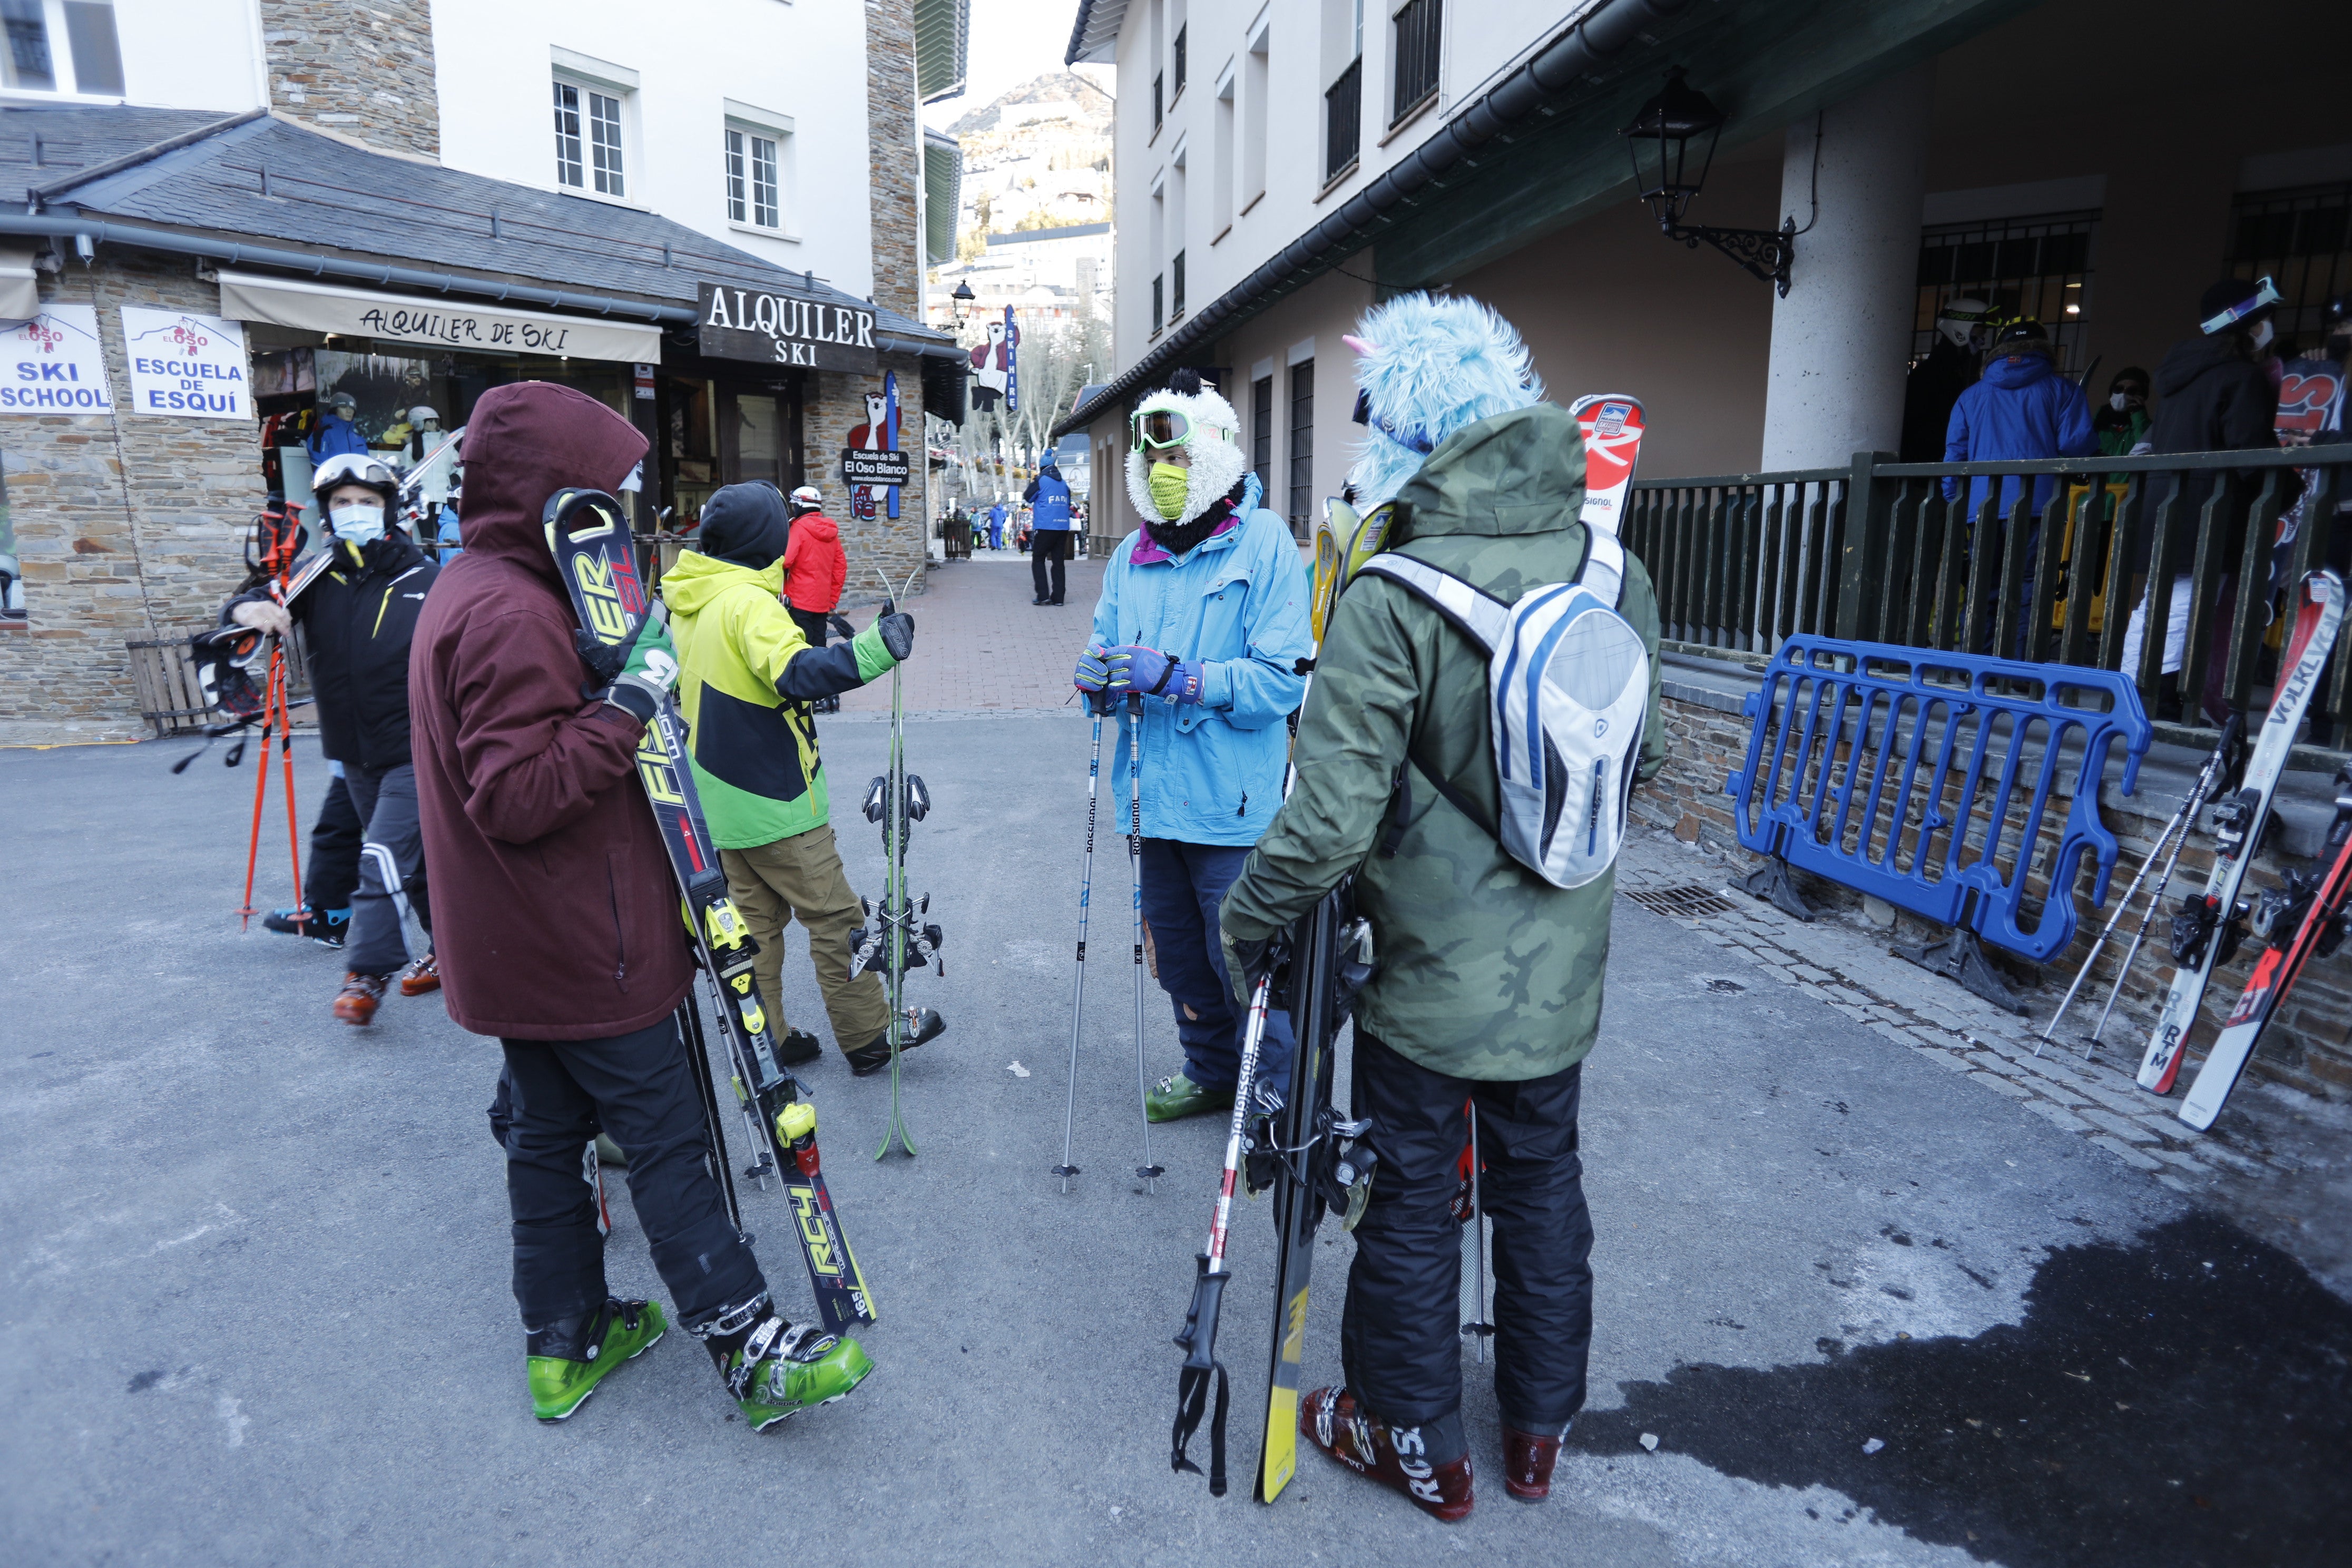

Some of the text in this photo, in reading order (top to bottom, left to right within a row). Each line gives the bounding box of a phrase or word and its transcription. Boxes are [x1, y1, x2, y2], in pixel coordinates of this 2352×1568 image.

[706, 287, 875, 348] ALQUILER
[29, 330, 64, 342] OSO
[174, 334, 208, 347] OSO
[360, 309, 569, 350] ALQUILER DE SKI
[775, 340, 817, 367] SKI
[16, 362, 80, 381] SKI
[135, 358, 243, 381] ESCUELA
[180, 379, 204, 391] DE
[0, 387, 111, 408] SCHOOL
[149, 389, 236, 413] ESQUÍ
[845, 460, 908, 475] El Oso Blanco
[852, 450, 900, 462] Escuela de Ski
[611, 544, 645, 615] SL
[789, 1187, 840, 1275] RC4
[822, 1211, 846, 1271] WORLDCUP
[851, 1291, 869, 1318] 165
